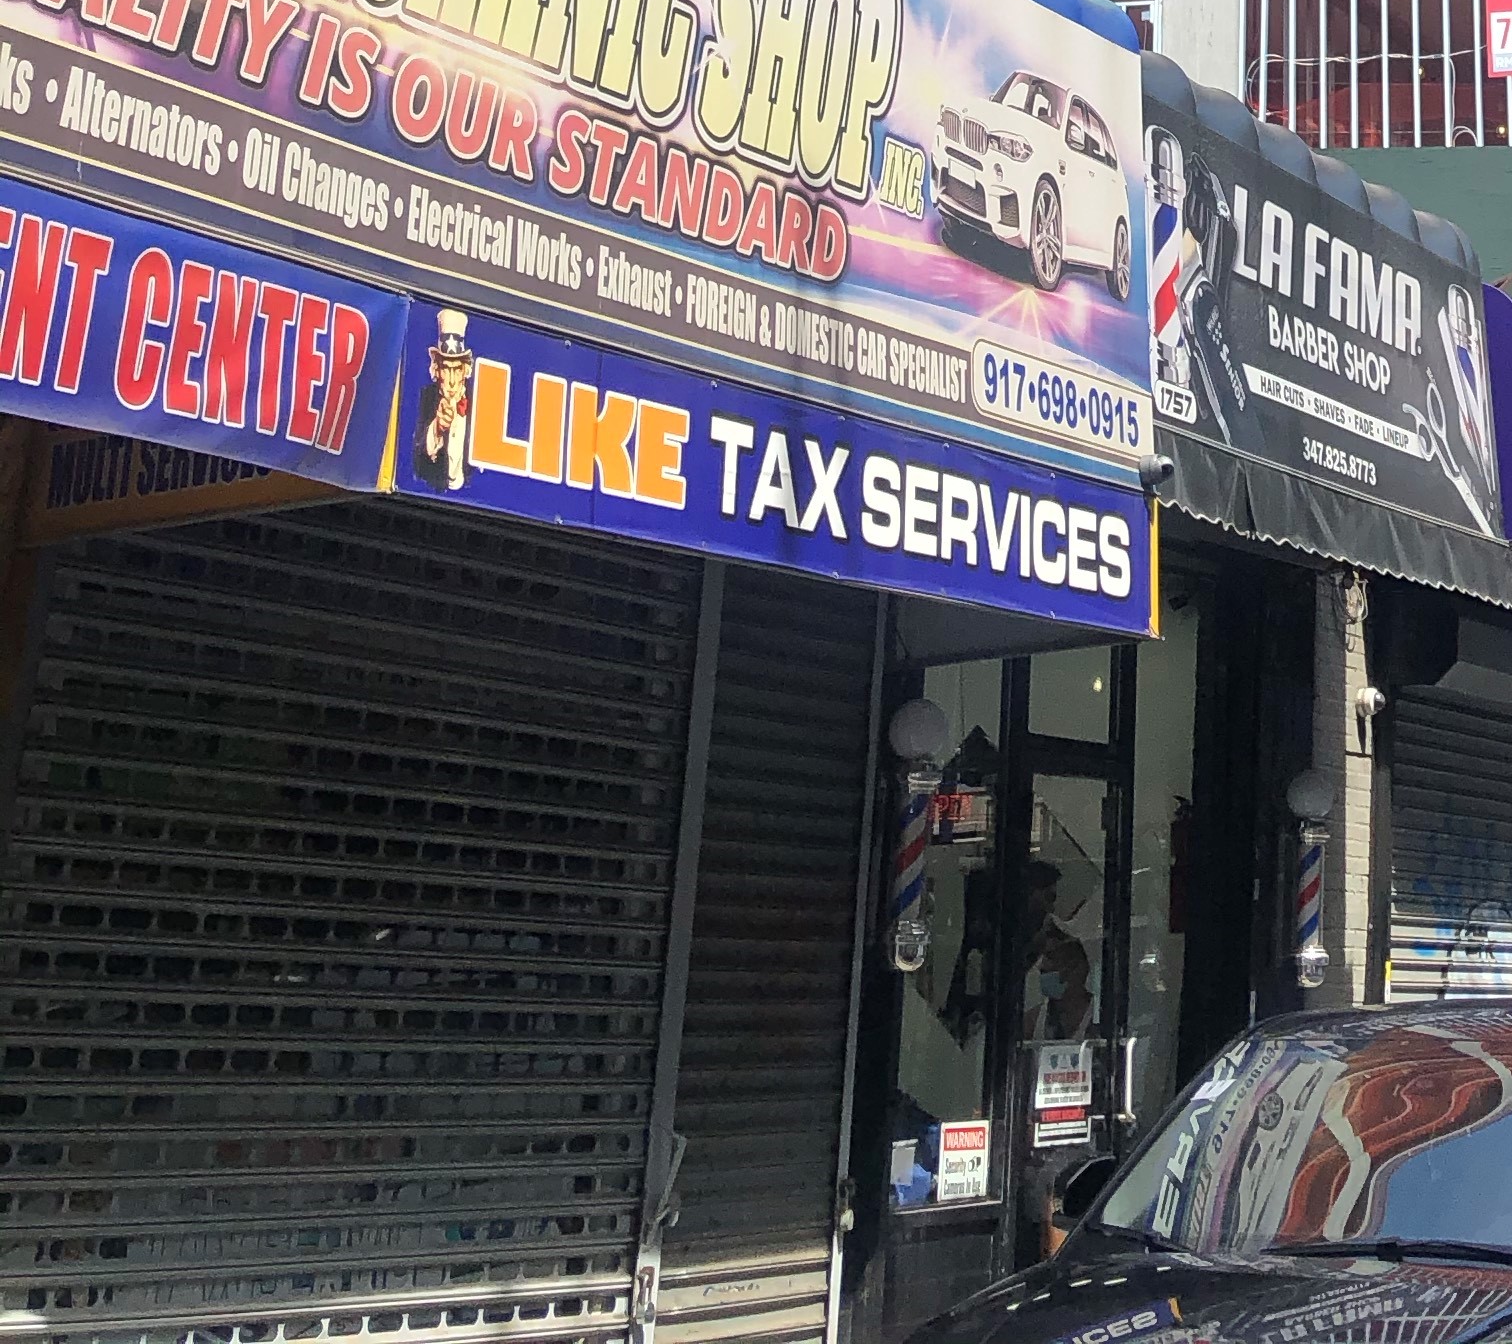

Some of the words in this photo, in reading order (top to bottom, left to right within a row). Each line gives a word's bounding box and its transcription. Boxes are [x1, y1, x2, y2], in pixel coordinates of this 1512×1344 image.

[300, 13, 382, 120] IS
[393, 54, 540, 182] OUR
[547, 109, 849, 283] STANDARD
[880, 138, 925, 218] INC.
[59, 65, 224, 176] Alternators
[242, 127, 282, 197] Oil
[282, 141, 390, 232] Changes
[406, 183, 513, 270] Electrical
[516, 218, 583, 291] Works
[597, 244, 673, 318] Exhaust
[686, 274, 757, 346] FOREIGN
[759, 303, 772, 346] &
[775, 304, 855, 373] DOMESTIC
[856, 330, 887, 381] CAR
[888, 346, 968, 404] SPECIALIST
[1231, 183, 1294, 298] LA
[114, 246, 370, 456] CENTER
[1267, 304, 1340, 377] BARBER
[1344, 342, 1391, 395] SHOP
[1160, 386, 1193, 419] 1757
[1260, 375, 1283, 402] HAIR
[1283, 384, 1305, 409] CUTS
[1313, 393, 1346, 425] SHAVES
[1354, 411, 1375, 437] FADE
[1382, 422, 1409, 450] LINEUP
[468, 356, 691, 511] LIKE
[710, 417, 850, 540] TAX
[861, 455, 1132, 598] SERVICES
[1302, 436, 1378, 487] 347.825.8773
[946, 1130, 984, 1149] WARNING
